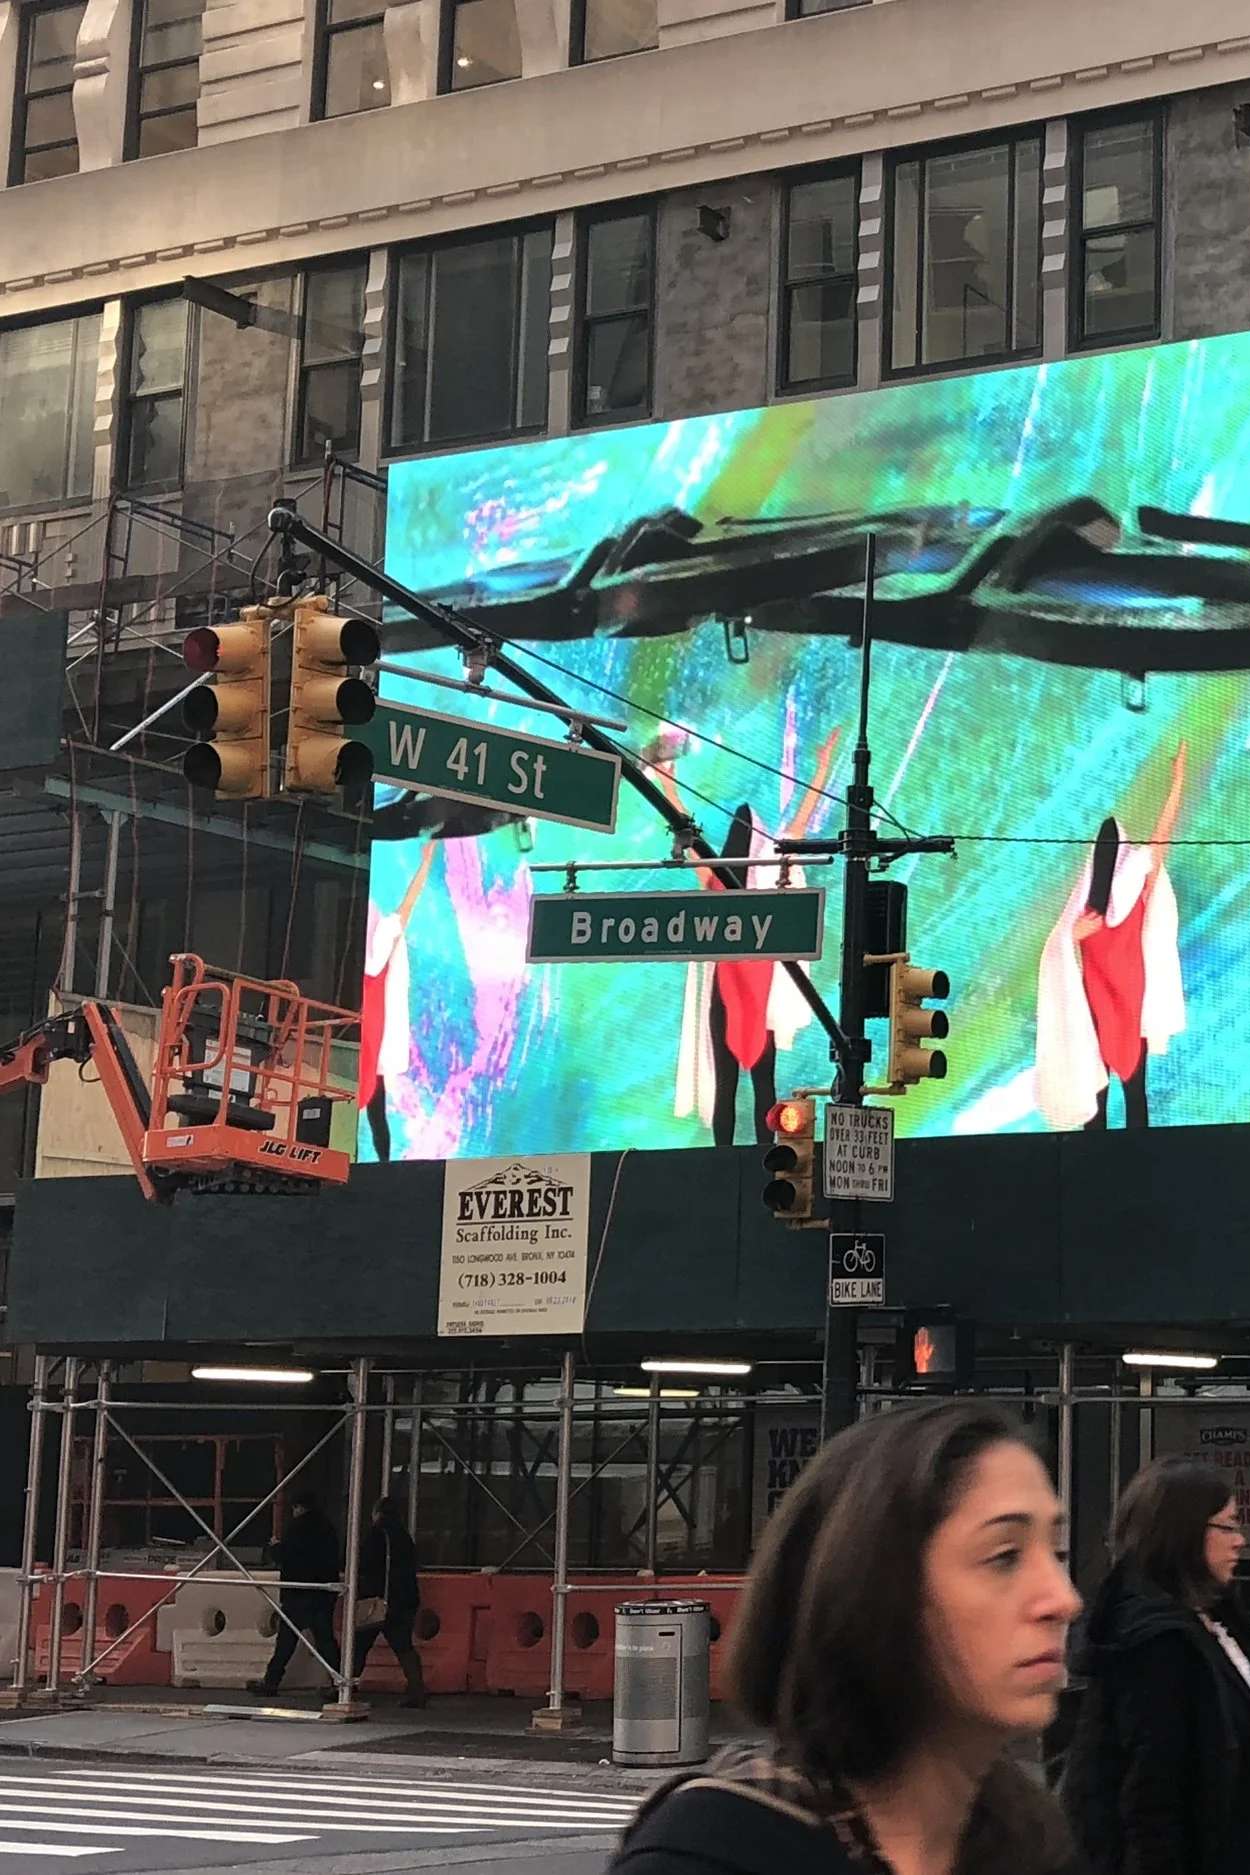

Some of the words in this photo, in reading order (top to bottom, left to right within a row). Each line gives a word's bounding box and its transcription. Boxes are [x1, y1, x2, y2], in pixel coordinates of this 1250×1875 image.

[389, 720, 426, 769] W
[446, 737, 488, 785] 41
[507, 751, 547, 799] St
[571, 909, 773, 950] Broadway
[831, 1112, 845, 1126] NO
[849, 1114, 888, 1130] TRUCKS
[829, 1127, 850, 1142] OVER
[854, 1129, 864, 1144] 33
[868, 1131, 888, 1145] FEET
[259, 1140, 287, 1159] JLG
[289, 1146, 322, 1164] LIFT
[837, 1144, 848, 1157] AT
[852, 1145, 880, 1160] CURB
[829, 1159, 855, 1174] NOON
[857, 1163, 866, 1173] TO
[868, 1162, 875, 1175] 6
[878, 1164, 888, 1173] PM
[829, 1175, 850, 1189] MON
[852, 1179, 870, 1189] THRU
[872, 1178, 888, 1192] FRI
[457, 1187, 573, 1220] EVEREST
[456, 1225, 538, 1244] Scaffolding
[545, 1225, 572, 1240] Inc.
[467, 1253, 504, 1264] LONGWOOD
[546, 1251, 555, 1260] NY
[458, 1271, 496, 1289] (718)
[498, 1270, 567, 1287] 328-1004
[834, 1282, 857, 1299] BIKE
[861, 1281, 882, 1298] LANE
[769, 1428, 817, 1457] WE
[1201, 1429, 1247, 1444] CHAMPS
